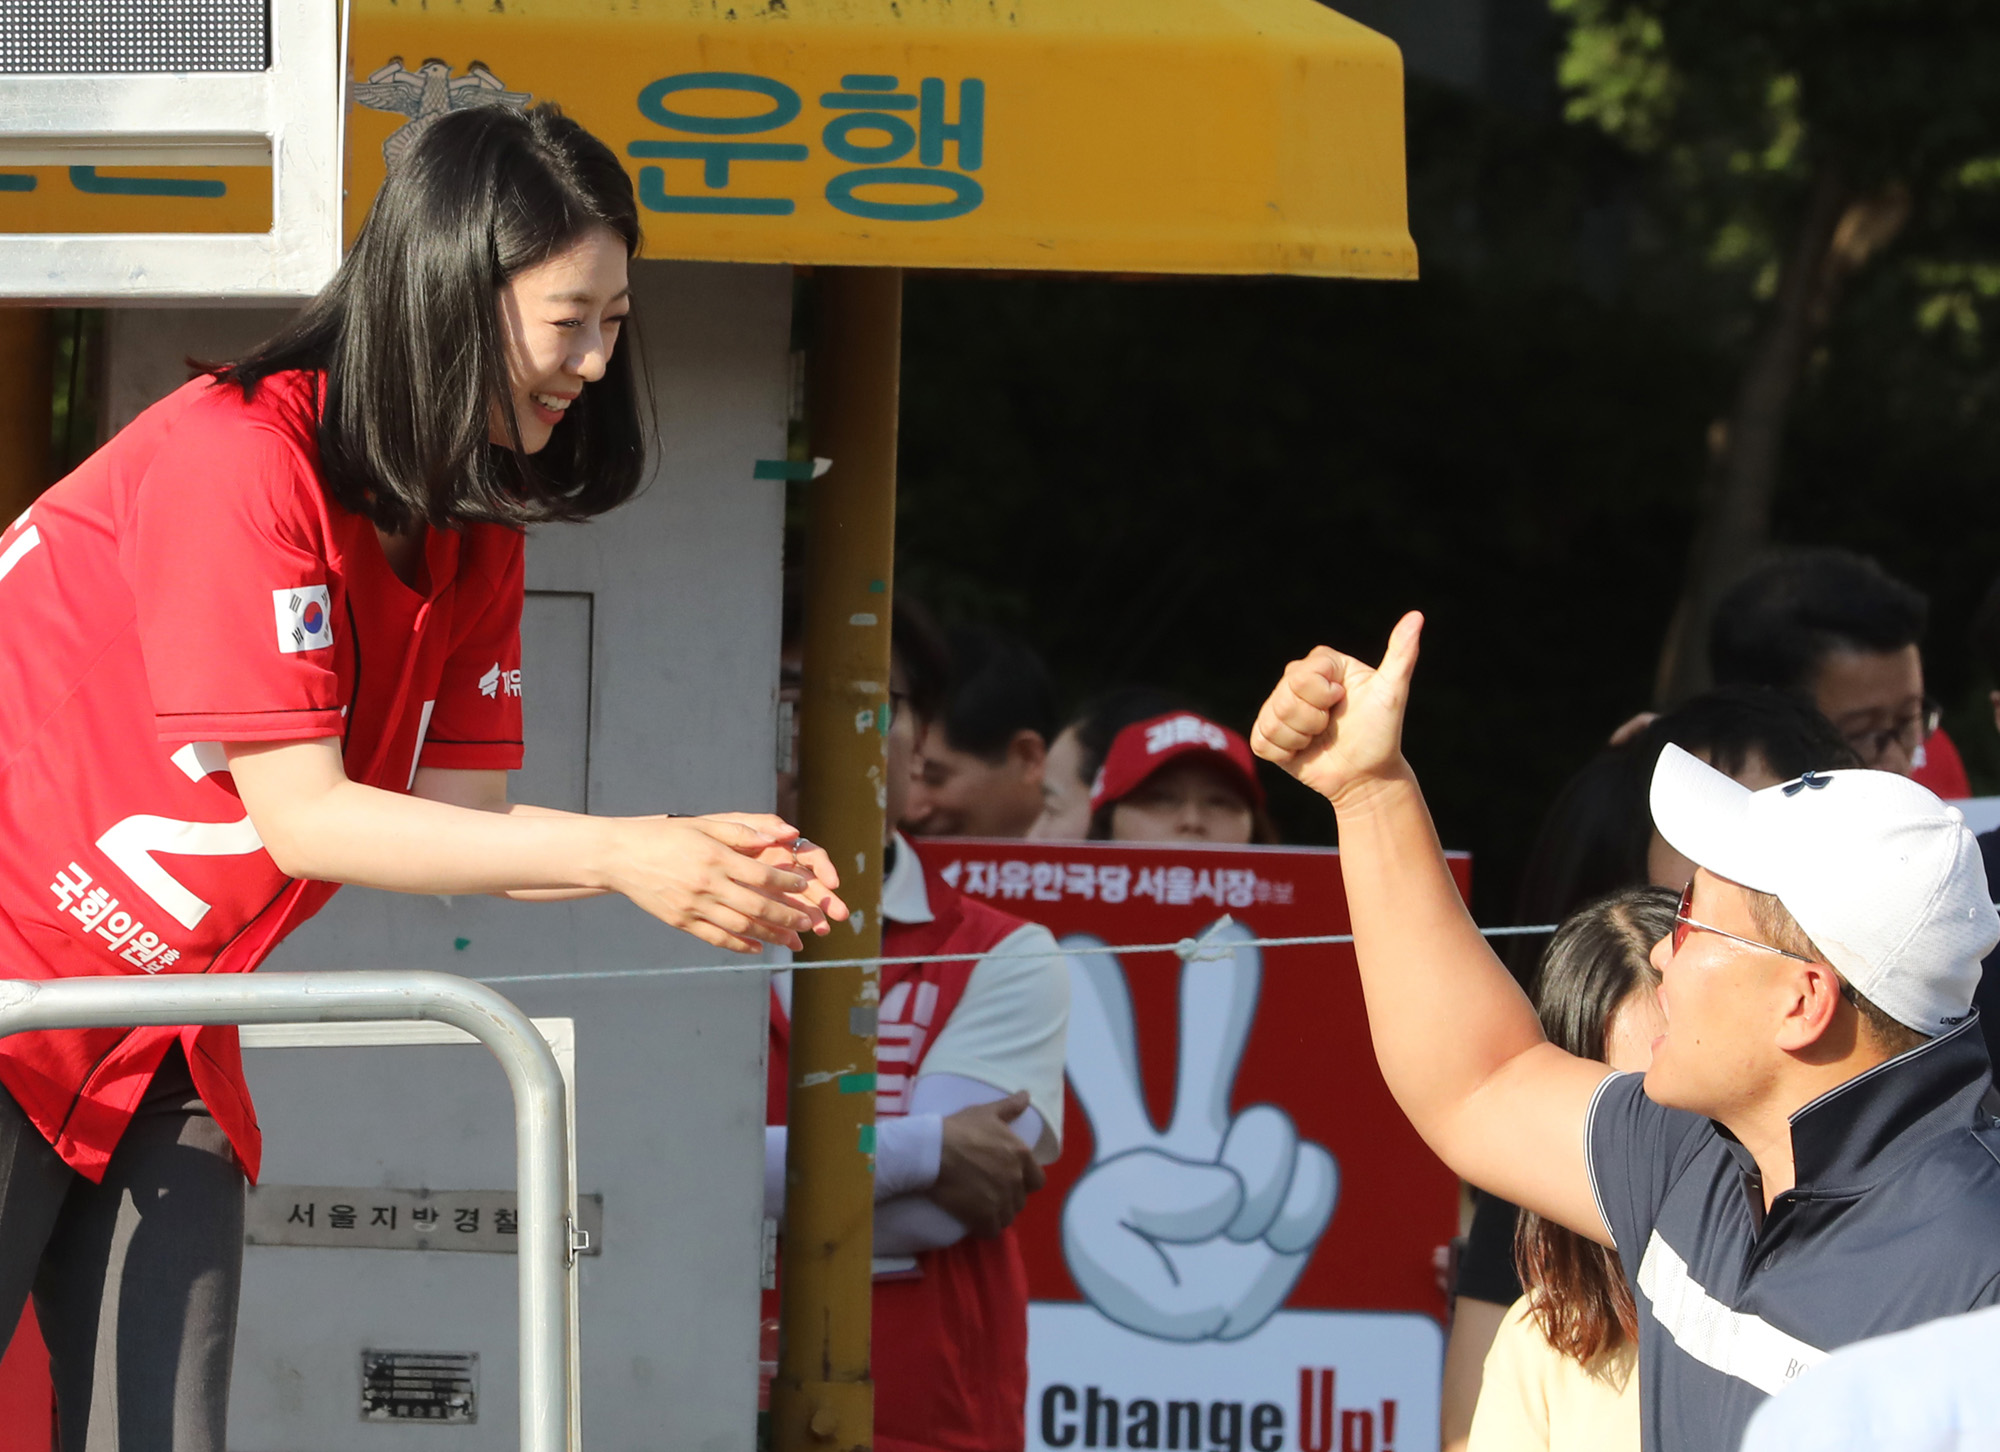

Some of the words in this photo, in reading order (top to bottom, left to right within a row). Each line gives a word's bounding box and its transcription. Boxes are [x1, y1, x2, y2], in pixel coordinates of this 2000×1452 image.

[627, 72, 985, 221] 운행
[50, 861, 169, 969] 국회의원
[964, 861, 1131, 903] 자유한국당
[1132, 866, 1256, 908] 서울시장
[1041, 1383, 1284, 1452] Change
